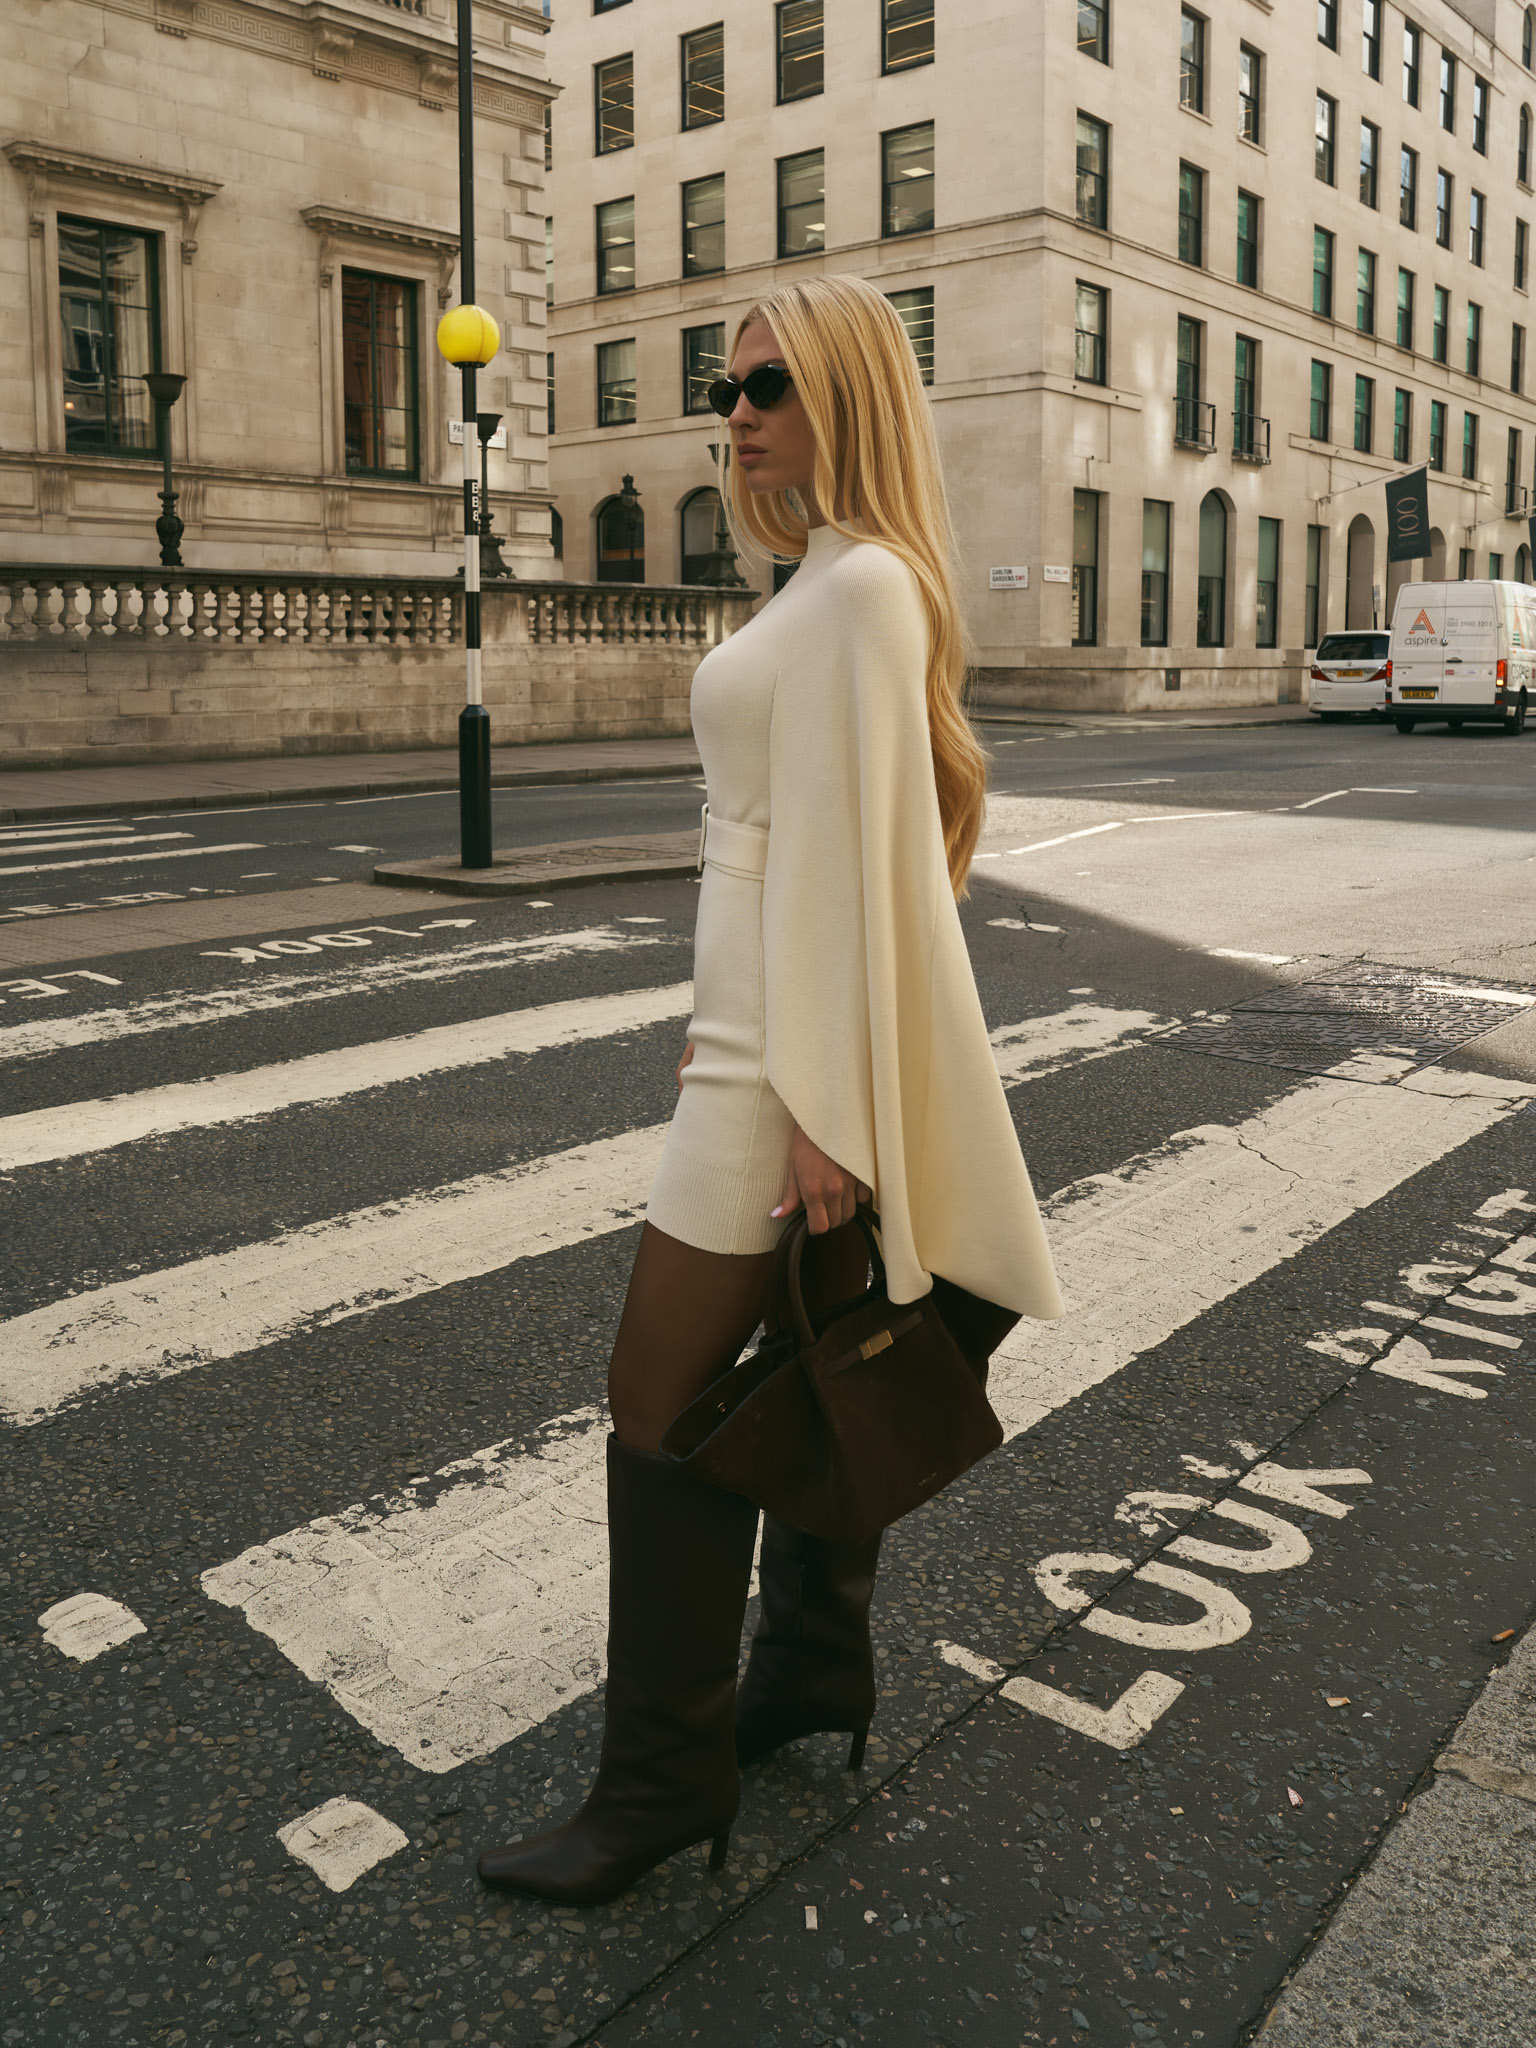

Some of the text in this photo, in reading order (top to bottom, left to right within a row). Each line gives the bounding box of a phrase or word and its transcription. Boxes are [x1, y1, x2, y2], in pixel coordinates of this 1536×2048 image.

[1404, 636, 1438, 647] aspire
[199, 925, 424, 963] LOOK
[933, 1438, 1373, 1750] LOOK
